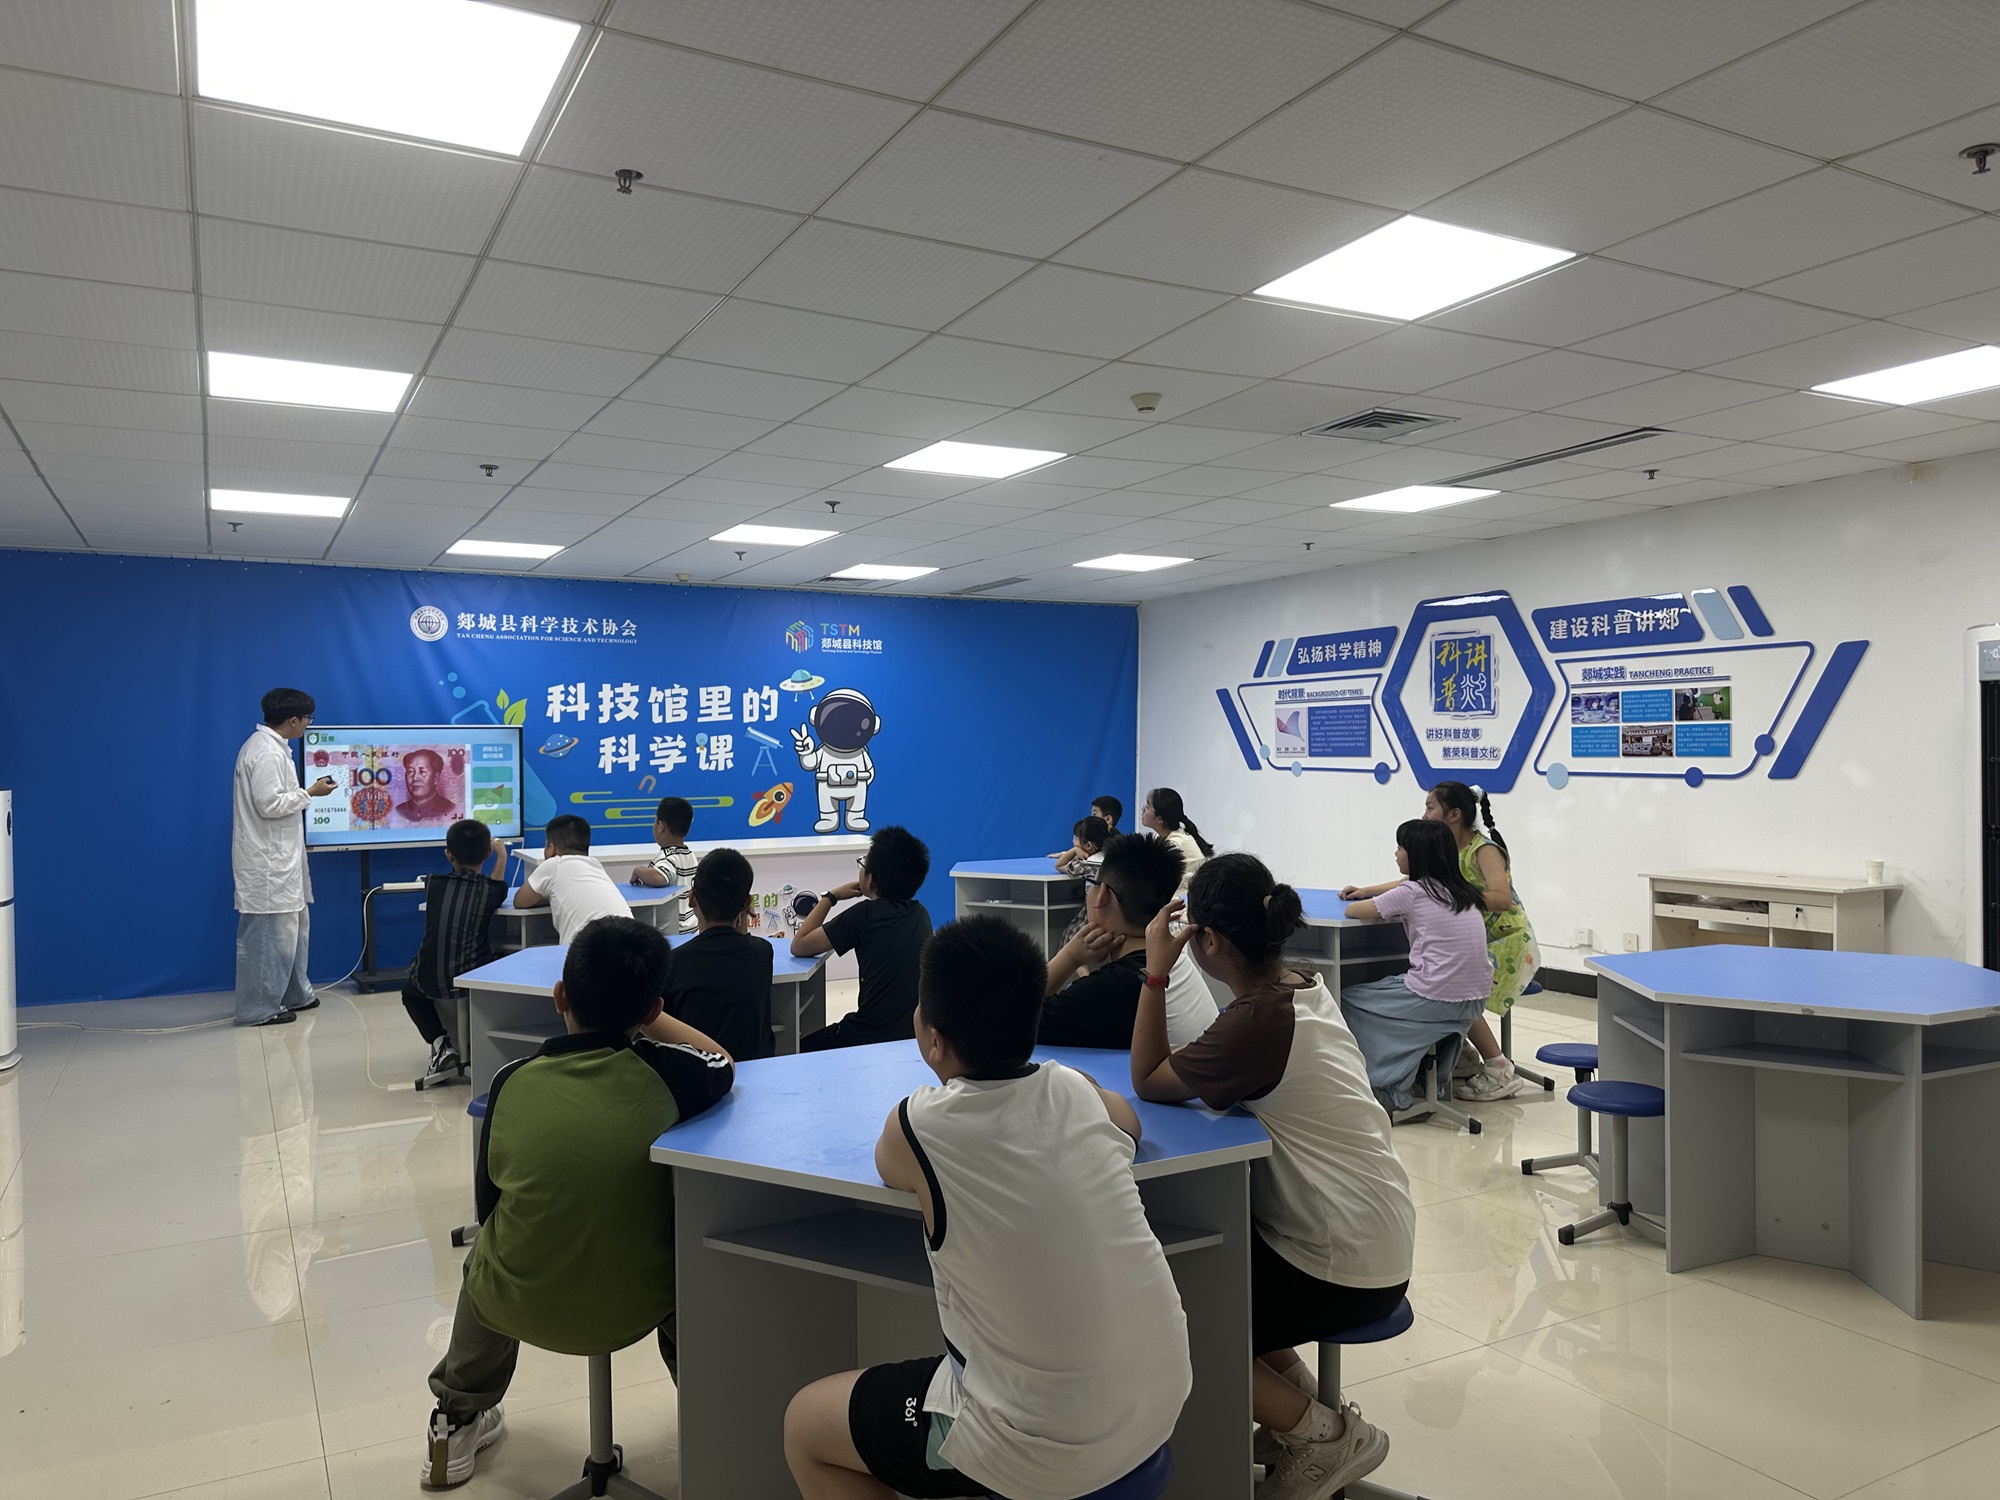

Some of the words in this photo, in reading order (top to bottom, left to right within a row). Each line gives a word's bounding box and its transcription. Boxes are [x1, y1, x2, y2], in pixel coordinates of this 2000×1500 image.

[456, 612, 638, 636] 郯城县科学技术协会
[820, 623, 860, 637] TSTM
[1549, 606, 1681, 641] 建设科普讲郯
[821, 637, 883, 651] 郯城县科技馆
[1298, 639, 1382, 664] 弘扬科学精神
[1582, 666, 1626, 680] 郯城实践
[1629, 669, 1671, 679] TANCHENG
[1674, 666, 1713, 676] PRACTICE
[1278, 688, 1305, 699] 时代背景
[1306, 690, 1339, 698] BACKGROUND
[546, 682, 779, 724] 科技馆里的
[1426, 728, 1481, 741] 讲好科普故事
[447, 749, 465, 757] 100
[598, 733, 735, 775] 科学课
[1443, 747, 1499, 759] 繁荣科普文化
[350, 767, 392, 787] 100
[313, 816, 331, 825] 100
[904, 1397, 918, 1427] 361°
